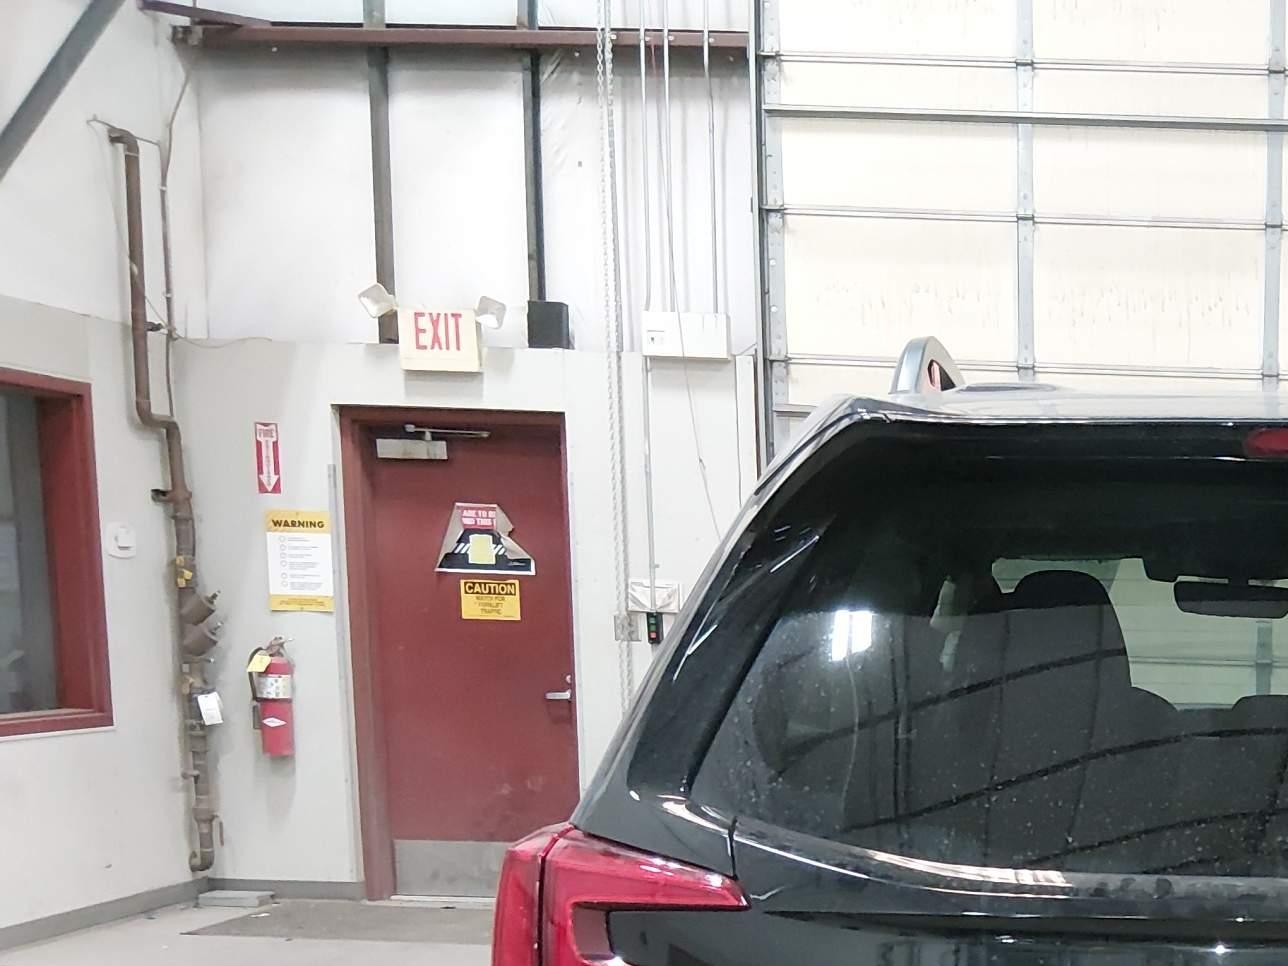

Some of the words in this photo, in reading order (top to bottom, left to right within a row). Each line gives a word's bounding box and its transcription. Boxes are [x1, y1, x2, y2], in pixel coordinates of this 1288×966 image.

[414, 311, 462, 351] EXIT
[271, 518, 325, 529] WARNING
[465, 583, 515, 595] CAUTION
